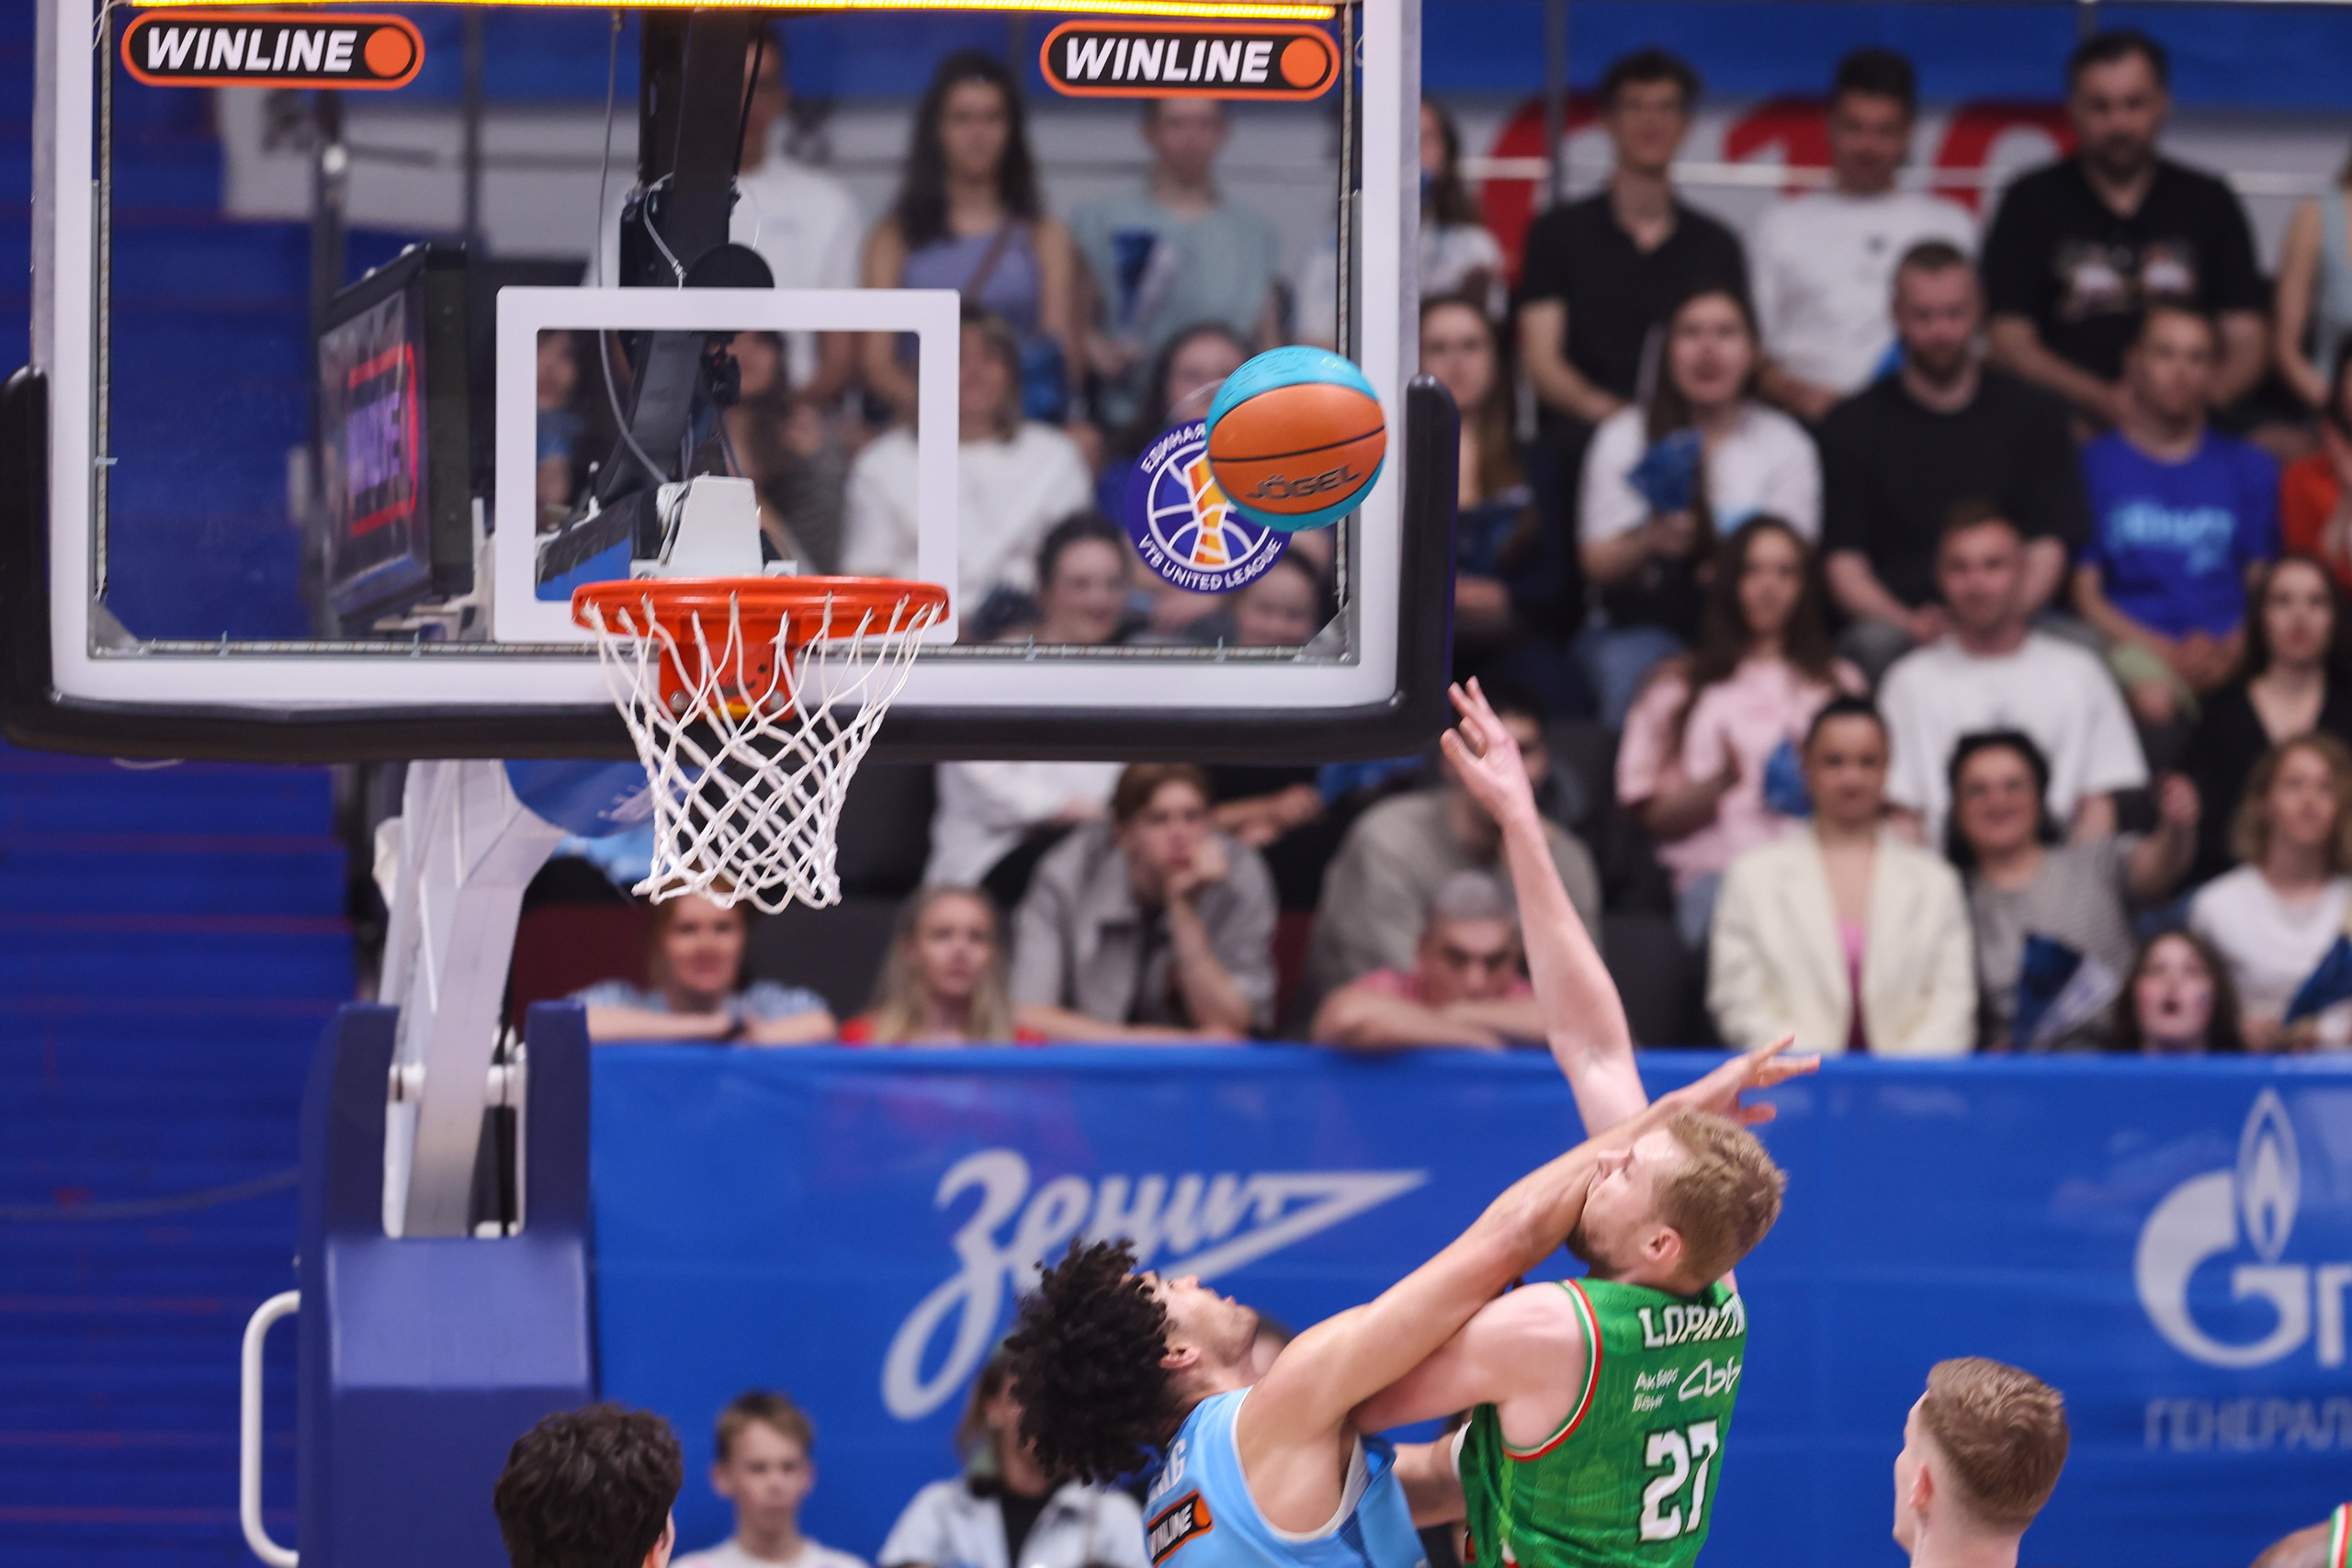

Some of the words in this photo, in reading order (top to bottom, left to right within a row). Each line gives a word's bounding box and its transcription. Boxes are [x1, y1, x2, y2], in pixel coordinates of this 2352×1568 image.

[148, 27, 357, 73] WINLINE
[1067, 37, 1274, 84] WINLINE
[1138, 533, 1165, 569] VTB
[1161, 563, 1223, 592] UNITED
[1224, 536, 1283, 590] LEAGUE
[1639, 1419, 1719, 1541] 27
